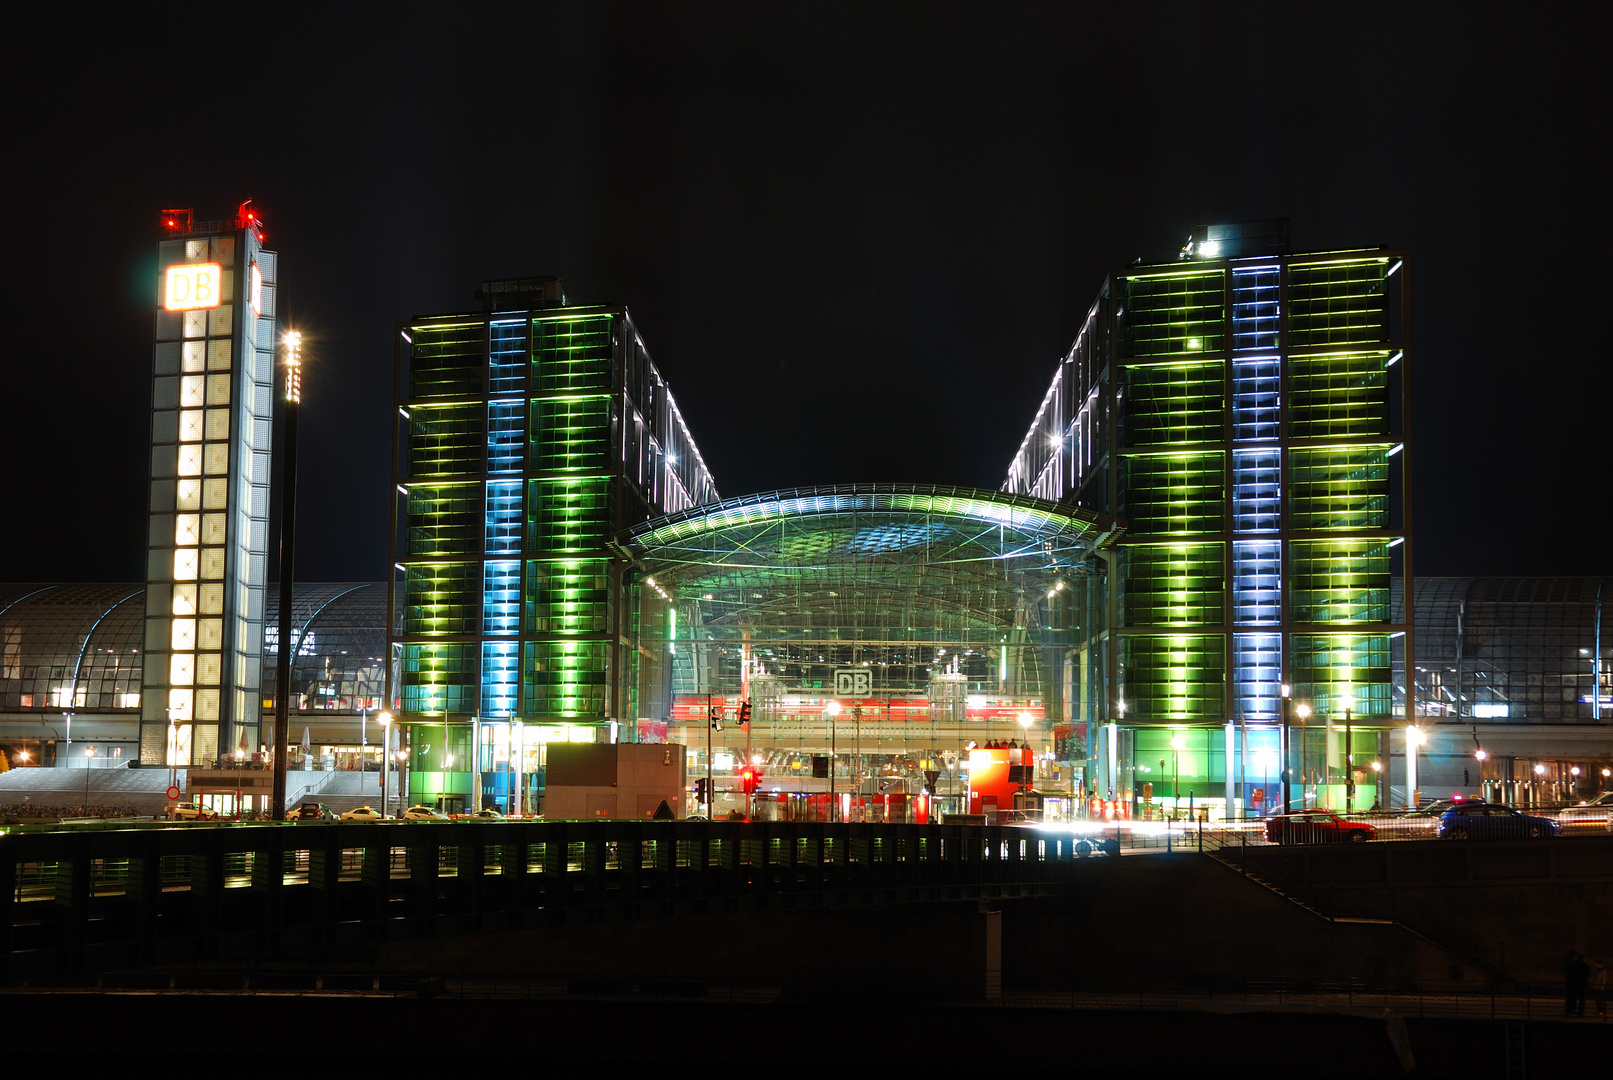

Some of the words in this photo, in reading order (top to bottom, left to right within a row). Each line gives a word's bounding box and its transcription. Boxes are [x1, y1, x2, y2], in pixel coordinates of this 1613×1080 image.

[174, 272, 211, 302] DB
[839, 674, 868, 694] DB
[770, 721, 814, 737] Berlin
[826, 721, 938, 738] Hauptbahnhof
